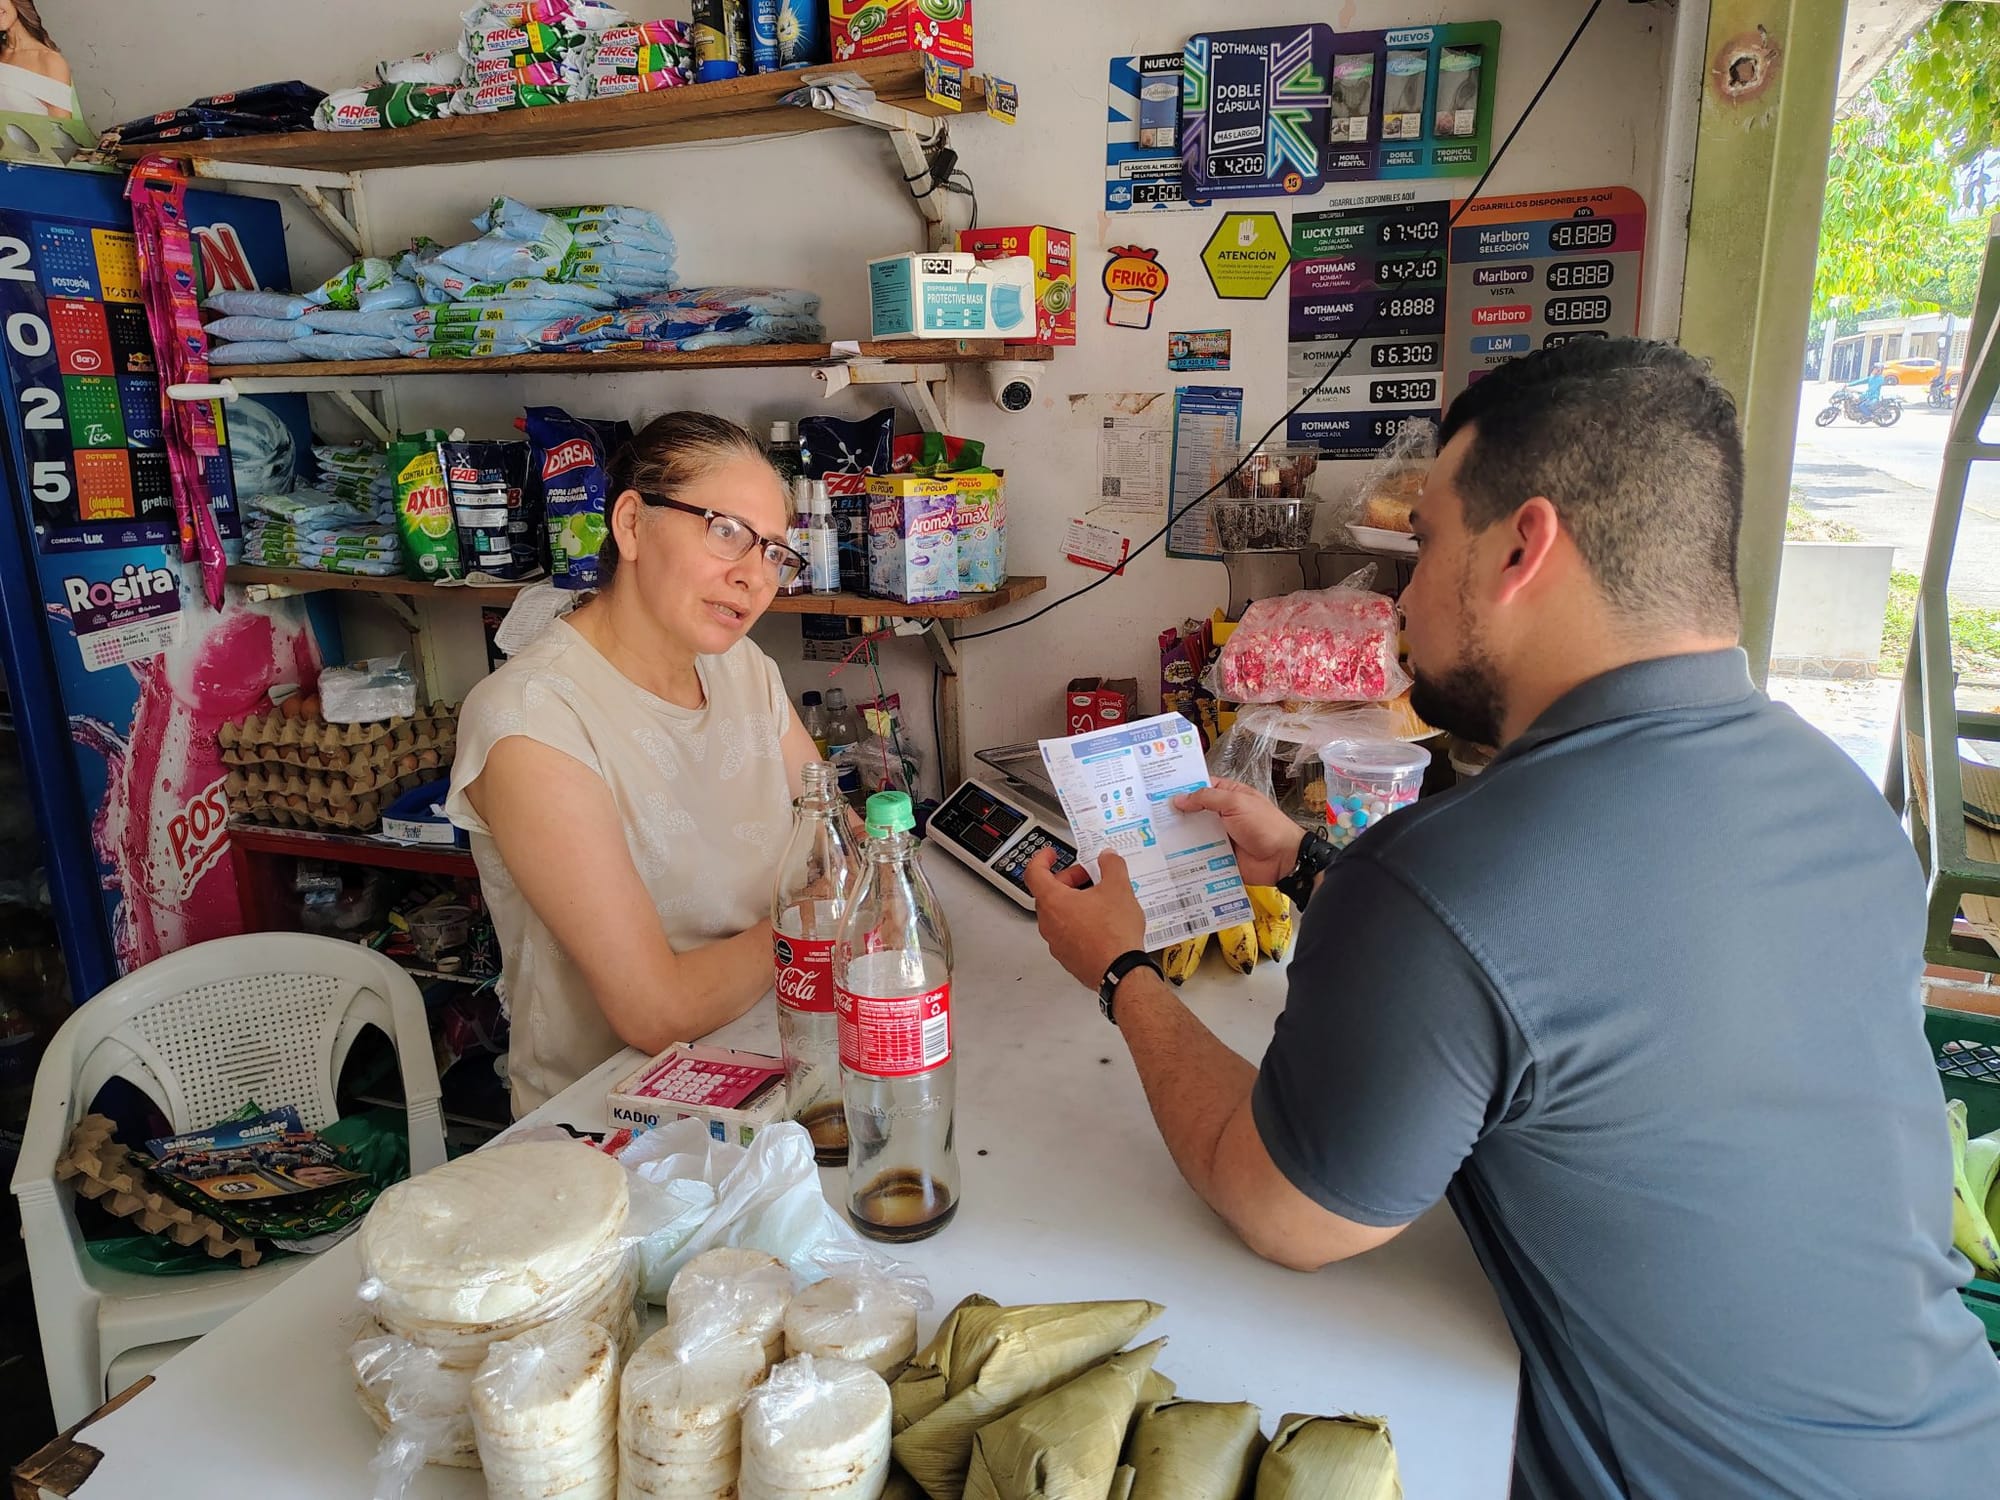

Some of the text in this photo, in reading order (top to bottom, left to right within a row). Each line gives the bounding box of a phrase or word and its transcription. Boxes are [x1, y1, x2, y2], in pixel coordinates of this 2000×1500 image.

[487, 28, 525, 42] ARIEL
[862, 31, 907, 46] INSECTICIDA
[1388, 32, 1430, 43] NUEVOS
[506, 38, 528, 46] PODER
[599, 46, 636, 56] ARIEL
[1212, 42, 1268, 56] ROTHMANS
[1144, 58, 1184, 69] NUEVOS
[600, 75, 636, 86] ARIEL
[476, 86, 513, 99] ARIEL
[1216, 84, 1262, 99] DOBLE
[338, 105, 378, 118] ARIEL
[1216, 99, 1260, 114] CÁPSULA
[1217, 129, 1259, 141] MÁS LARGOS
[1436, 148, 1472, 156] TROPICAL
[1224, 157, 1262, 174] 4.200
[1329, 192, 1416, 208] CIGARRILLOS DISPONIBLES AQUÍ
[1470, 193, 1612, 212] CIGARRILLOS DISPONIBLES AQUÍ
[1302, 225, 1365, 240] LUCKY STRIKE
[1383, 222, 1439, 241] $ 7.400
[1480, 230, 1530, 244] Marlboro
[1002, 237, 1018, 250] 50
[1048, 240, 1070, 258] Katori
[1479, 242, 1530, 254] SELECCIÓN
[1218, 248, 1276, 260] ATENCIÓN
[1306, 262, 1356, 274] ROTHMANS
[52, 275, 90, 291] POSTOBÓN
[1111, 268, 1158, 289] FRIKO
[1479, 270, 1528, 283] Marlboro
[1490, 288, 1516, 296] VISTA
[927, 294, 984, 304] PROTECTIVE MASK
[1304, 304, 1354, 316] ROTHMANS
[1390, 298, 1435, 316] 8.888
[1478, 309, 1526, 322] Marlboro
[1488, 338, 1512, 350] L&M
[76, 354, 96, 365] Bary
[1377, 346, 1432, 364] $ 6.300
[1376, 382, 1430, 400] $ 4.300
[1301, 421, 1350, 430] ROTHMANS
[1375, 422, 1382, 436] $
[548, 444, 592, 474] DERSA
[402, 468, 435, 481] CONTRA LA
[451, 468, 478, 482] FAB
[926, 484, 948, 492] POLVO
[958, 480, 982, 488] POLVO
[548, 488, 568, 496] ROPA
[868, 499, 900, 528] AromaX
[909, 506, 955, 536] AromaX
[51, 536, 82, 545] COMERCIAL
[64, 565, 174, 614] Rosita
[614, 1108, 658, 1126] KADIO
[238, 1120, 288, 1139] Gillette
[163, 1136, 216, 1150] Gillette
